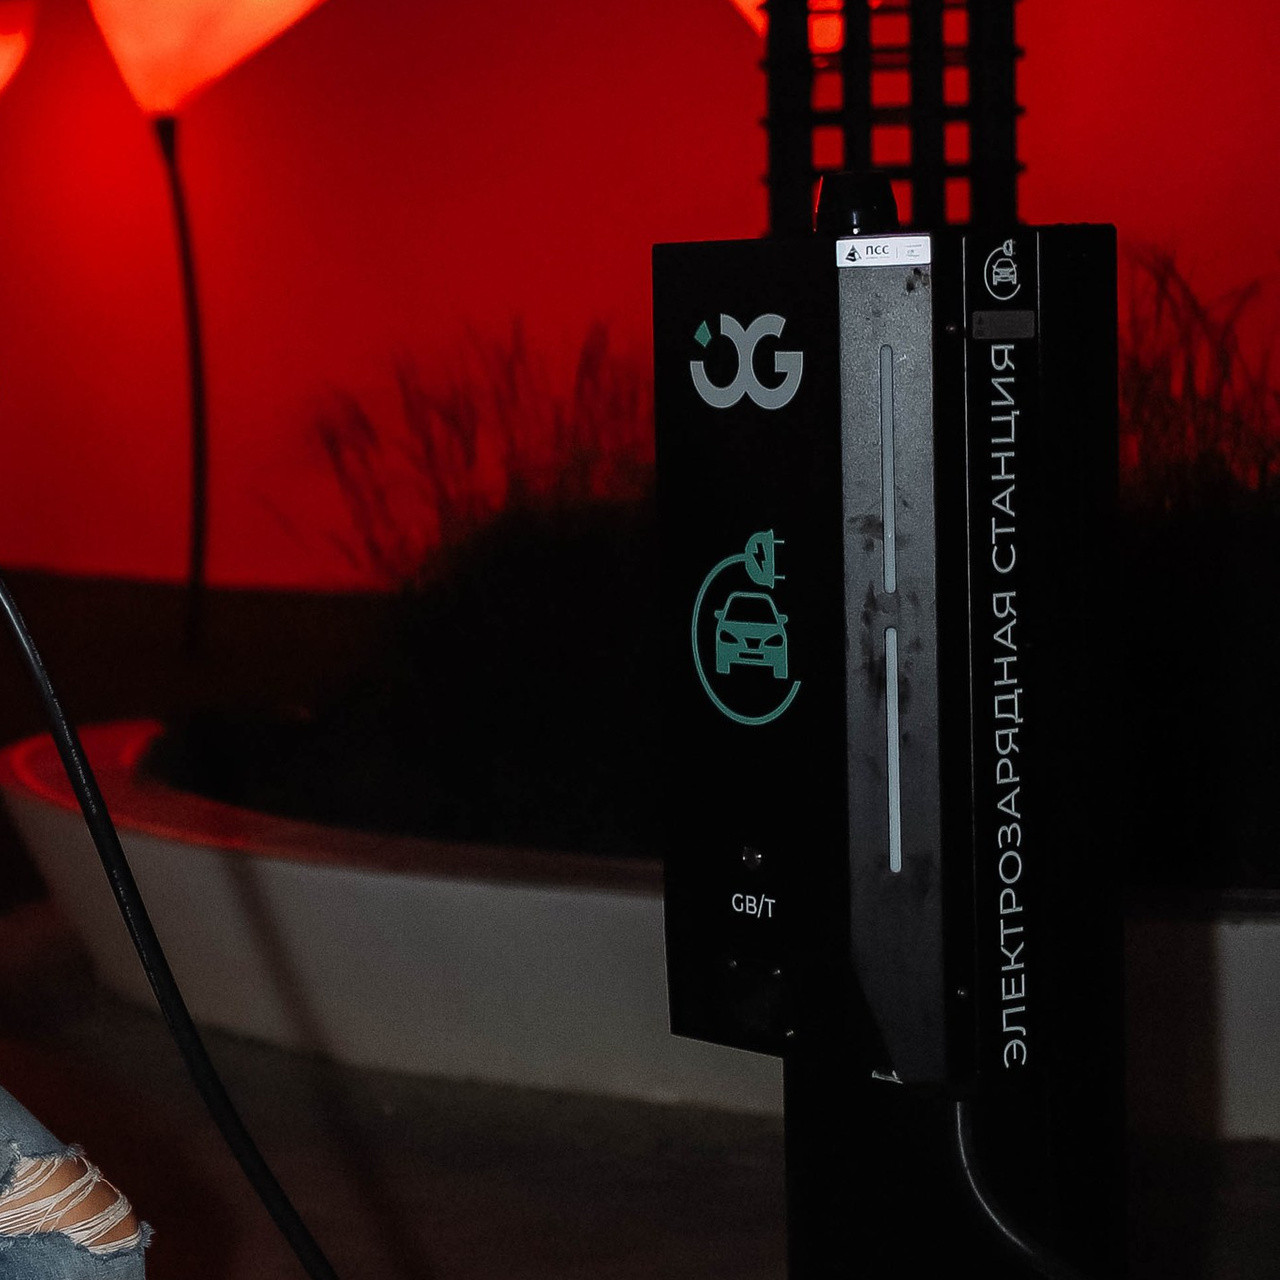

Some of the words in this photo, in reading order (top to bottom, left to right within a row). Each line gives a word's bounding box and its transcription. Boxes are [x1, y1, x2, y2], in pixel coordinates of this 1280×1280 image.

[991, 344, 1020, 574] СТАНЦИЯ
[731, 893, 776, 919] GB/T
[992, 591, 1027, 1068] ЭЛЕКТРОЗАРЯДНАЯ
